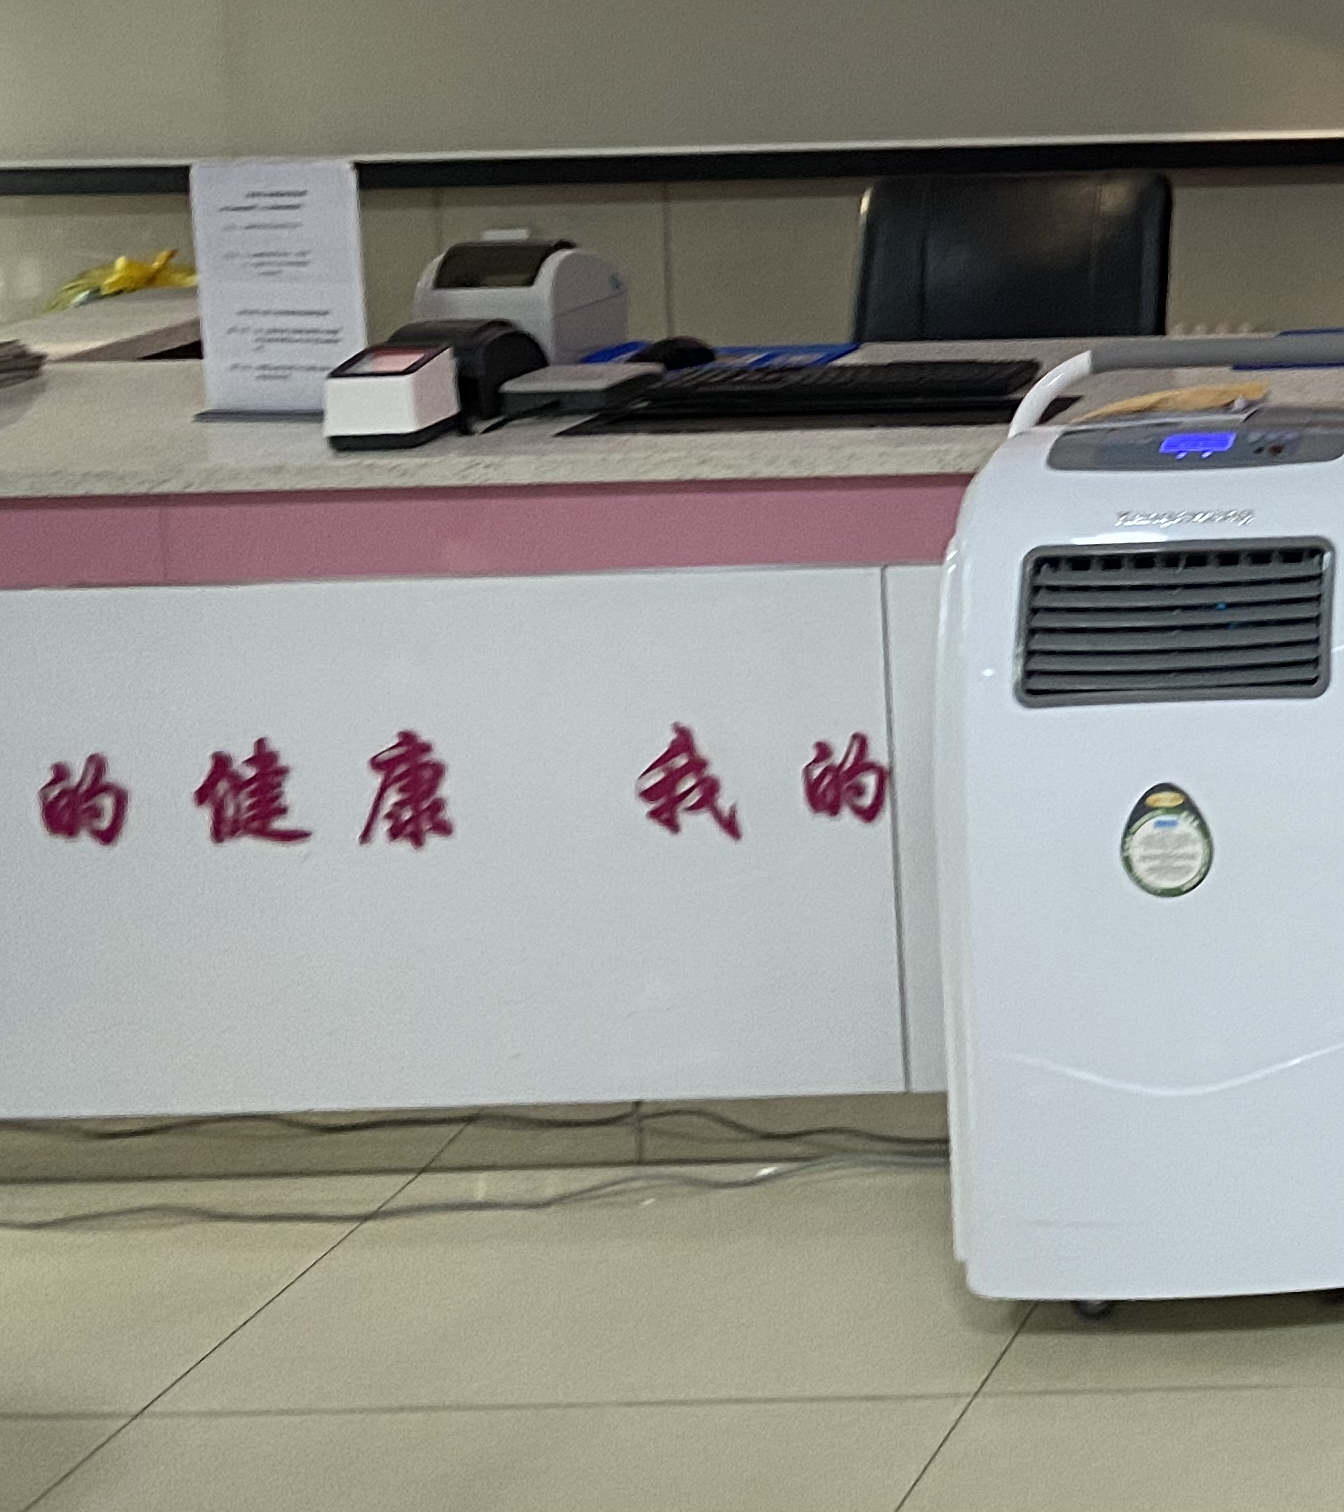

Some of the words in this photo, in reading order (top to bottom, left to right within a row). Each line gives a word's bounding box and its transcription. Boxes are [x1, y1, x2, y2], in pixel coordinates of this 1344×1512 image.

[38, 729, 455, 848] 的健康
[636, 722, 890, 841] 我的
